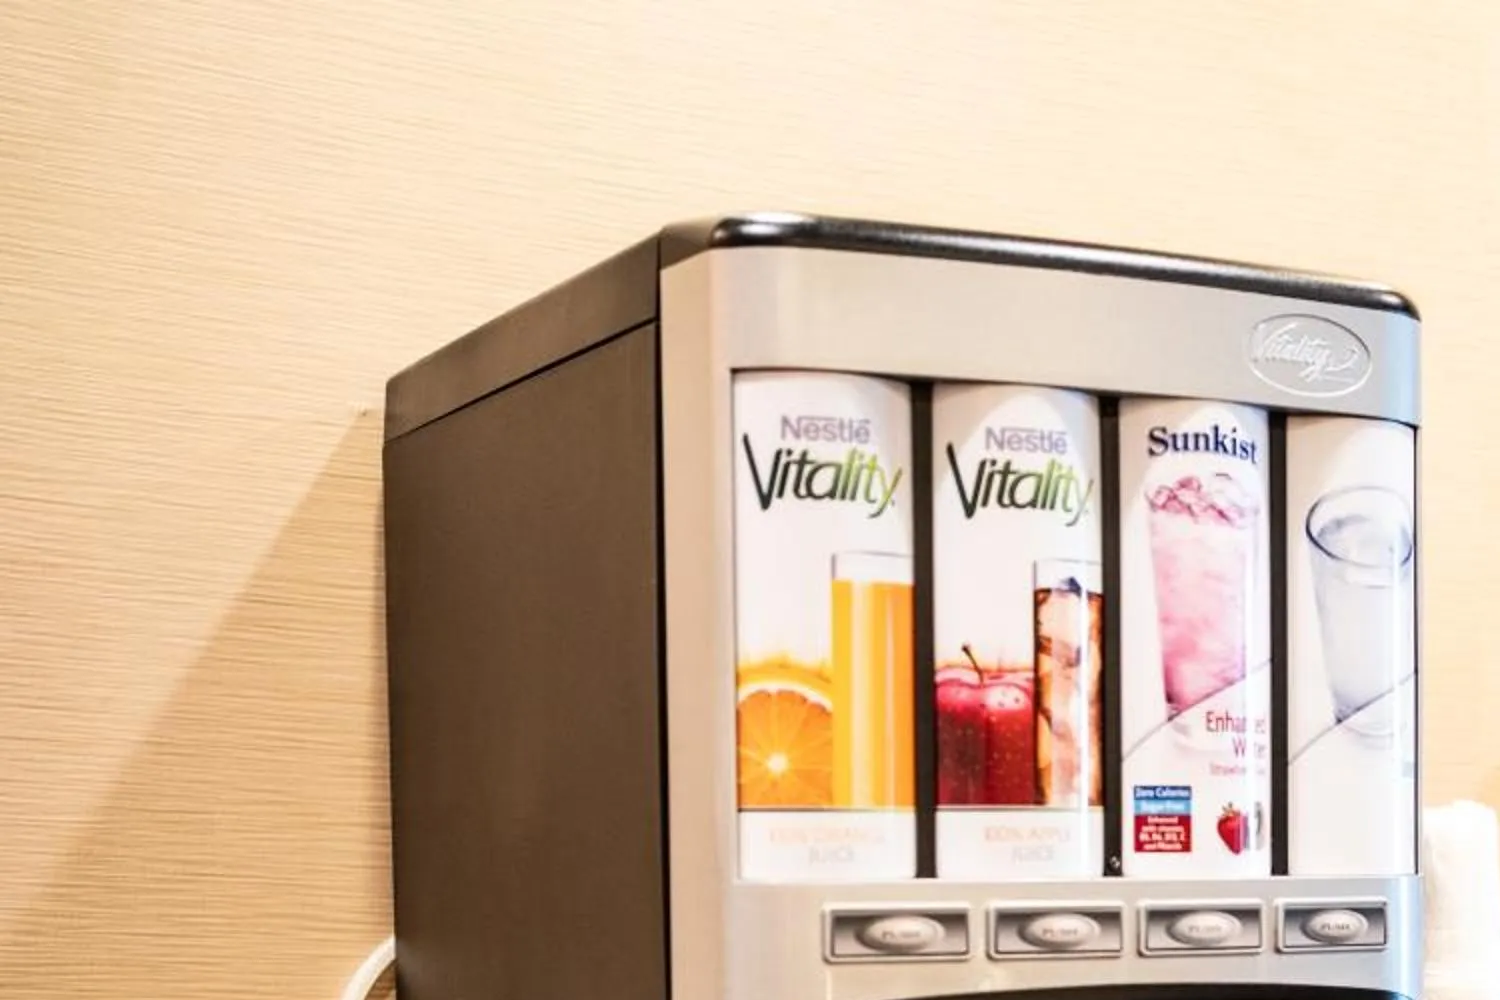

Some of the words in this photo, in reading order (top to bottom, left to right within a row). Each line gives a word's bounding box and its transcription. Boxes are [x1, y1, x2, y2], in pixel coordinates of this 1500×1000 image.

[743, 433, 902, 519] Vitality
[947, 442, 1095, 527] Vitality
[1148, 425, 1258, 464] Sunkist
